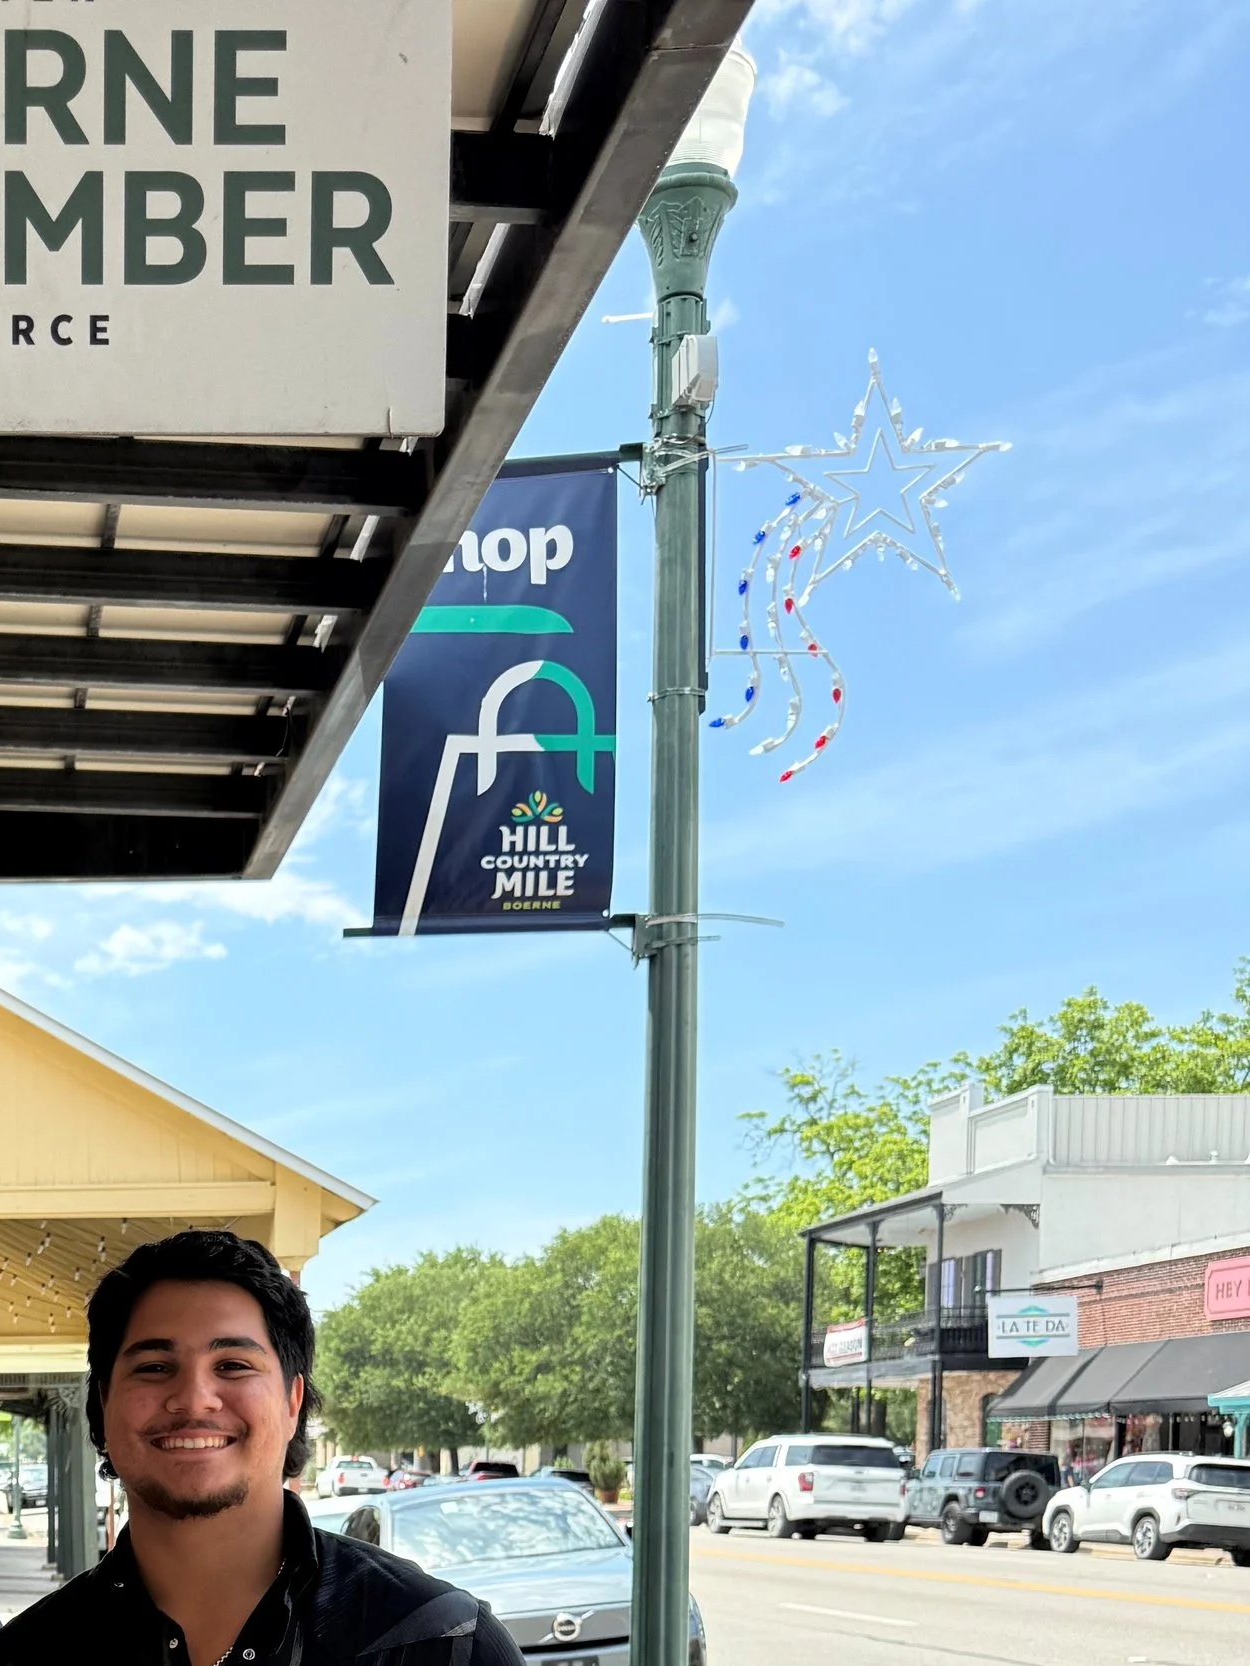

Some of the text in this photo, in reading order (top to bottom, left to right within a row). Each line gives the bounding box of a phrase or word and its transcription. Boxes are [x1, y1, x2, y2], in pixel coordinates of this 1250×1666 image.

[443, 524, 574, 585] hop
[498, 825, 576, 852] HILL
[480, 853, 590, 870] COUNTRY
[490, 870, 576, 900] MILE
[502, 901, 562, 911] BOERNE
[1215, 1279, 1243, 1301] HEY
[1001, 1320, 1019, 1334] LA
[1045, 1319, 1065, 1332] DA
